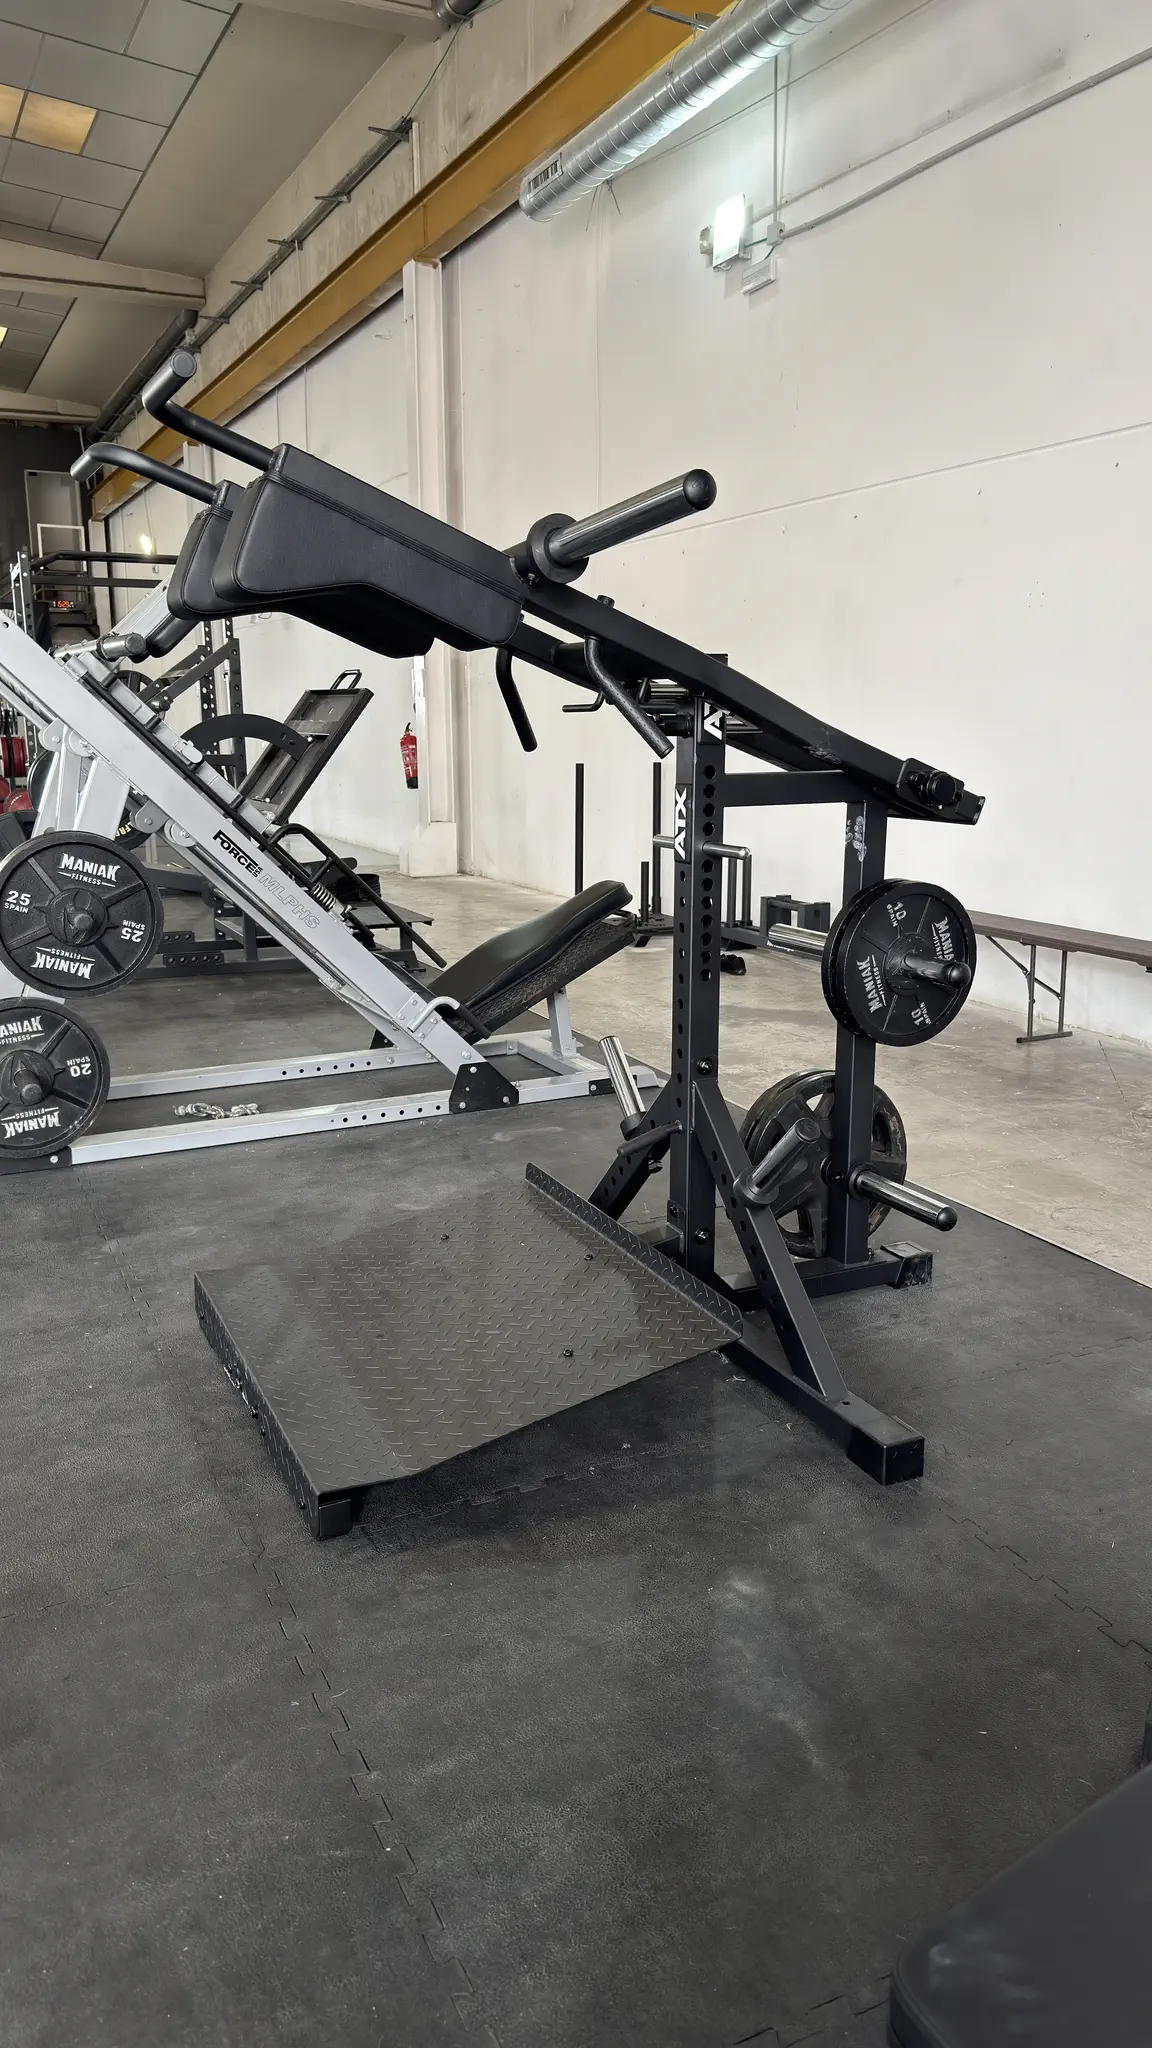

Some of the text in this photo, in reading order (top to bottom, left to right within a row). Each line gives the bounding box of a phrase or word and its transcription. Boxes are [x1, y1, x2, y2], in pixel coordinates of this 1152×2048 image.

[674, 787, 687, 861] ATX
[212, 829, 259, 874] FORCE
[58, 852, 121, 882] MANIAK
[71, 872, 102, 886] FITNESS
[6, 890, 32, 906] 25
[258, 873, 321, 929] MLPHS
[4, 902, 29, 914] SPAIN
[886, 903, 898, 928] SPAIN
[893, 902, 907, 920] 10
[122, 919, 146, 930] SPAIN
[120, 927, 144, 943] 25
[934, 916, 955, 961] MANIA
[51, 948, 81, 960] FITNESS
[31, 951, 95, 980] MANIAK
[856, 955, 883, 1013] MANIAK
[911, 1008, 924, 1026] 10
[919, 1001, 932, 1025] SPAIN
[0, 1015, 44, 1039] ANIAK
[1, 1034, 31, 1045] FITNESS
[66, 1055, 91, 1066] SPAIN
[70, 1063, 92, 1078] 20
[15, 1107, 45, 1120] FITNESS
[1, 1110, 61, 1139] MANIAK
